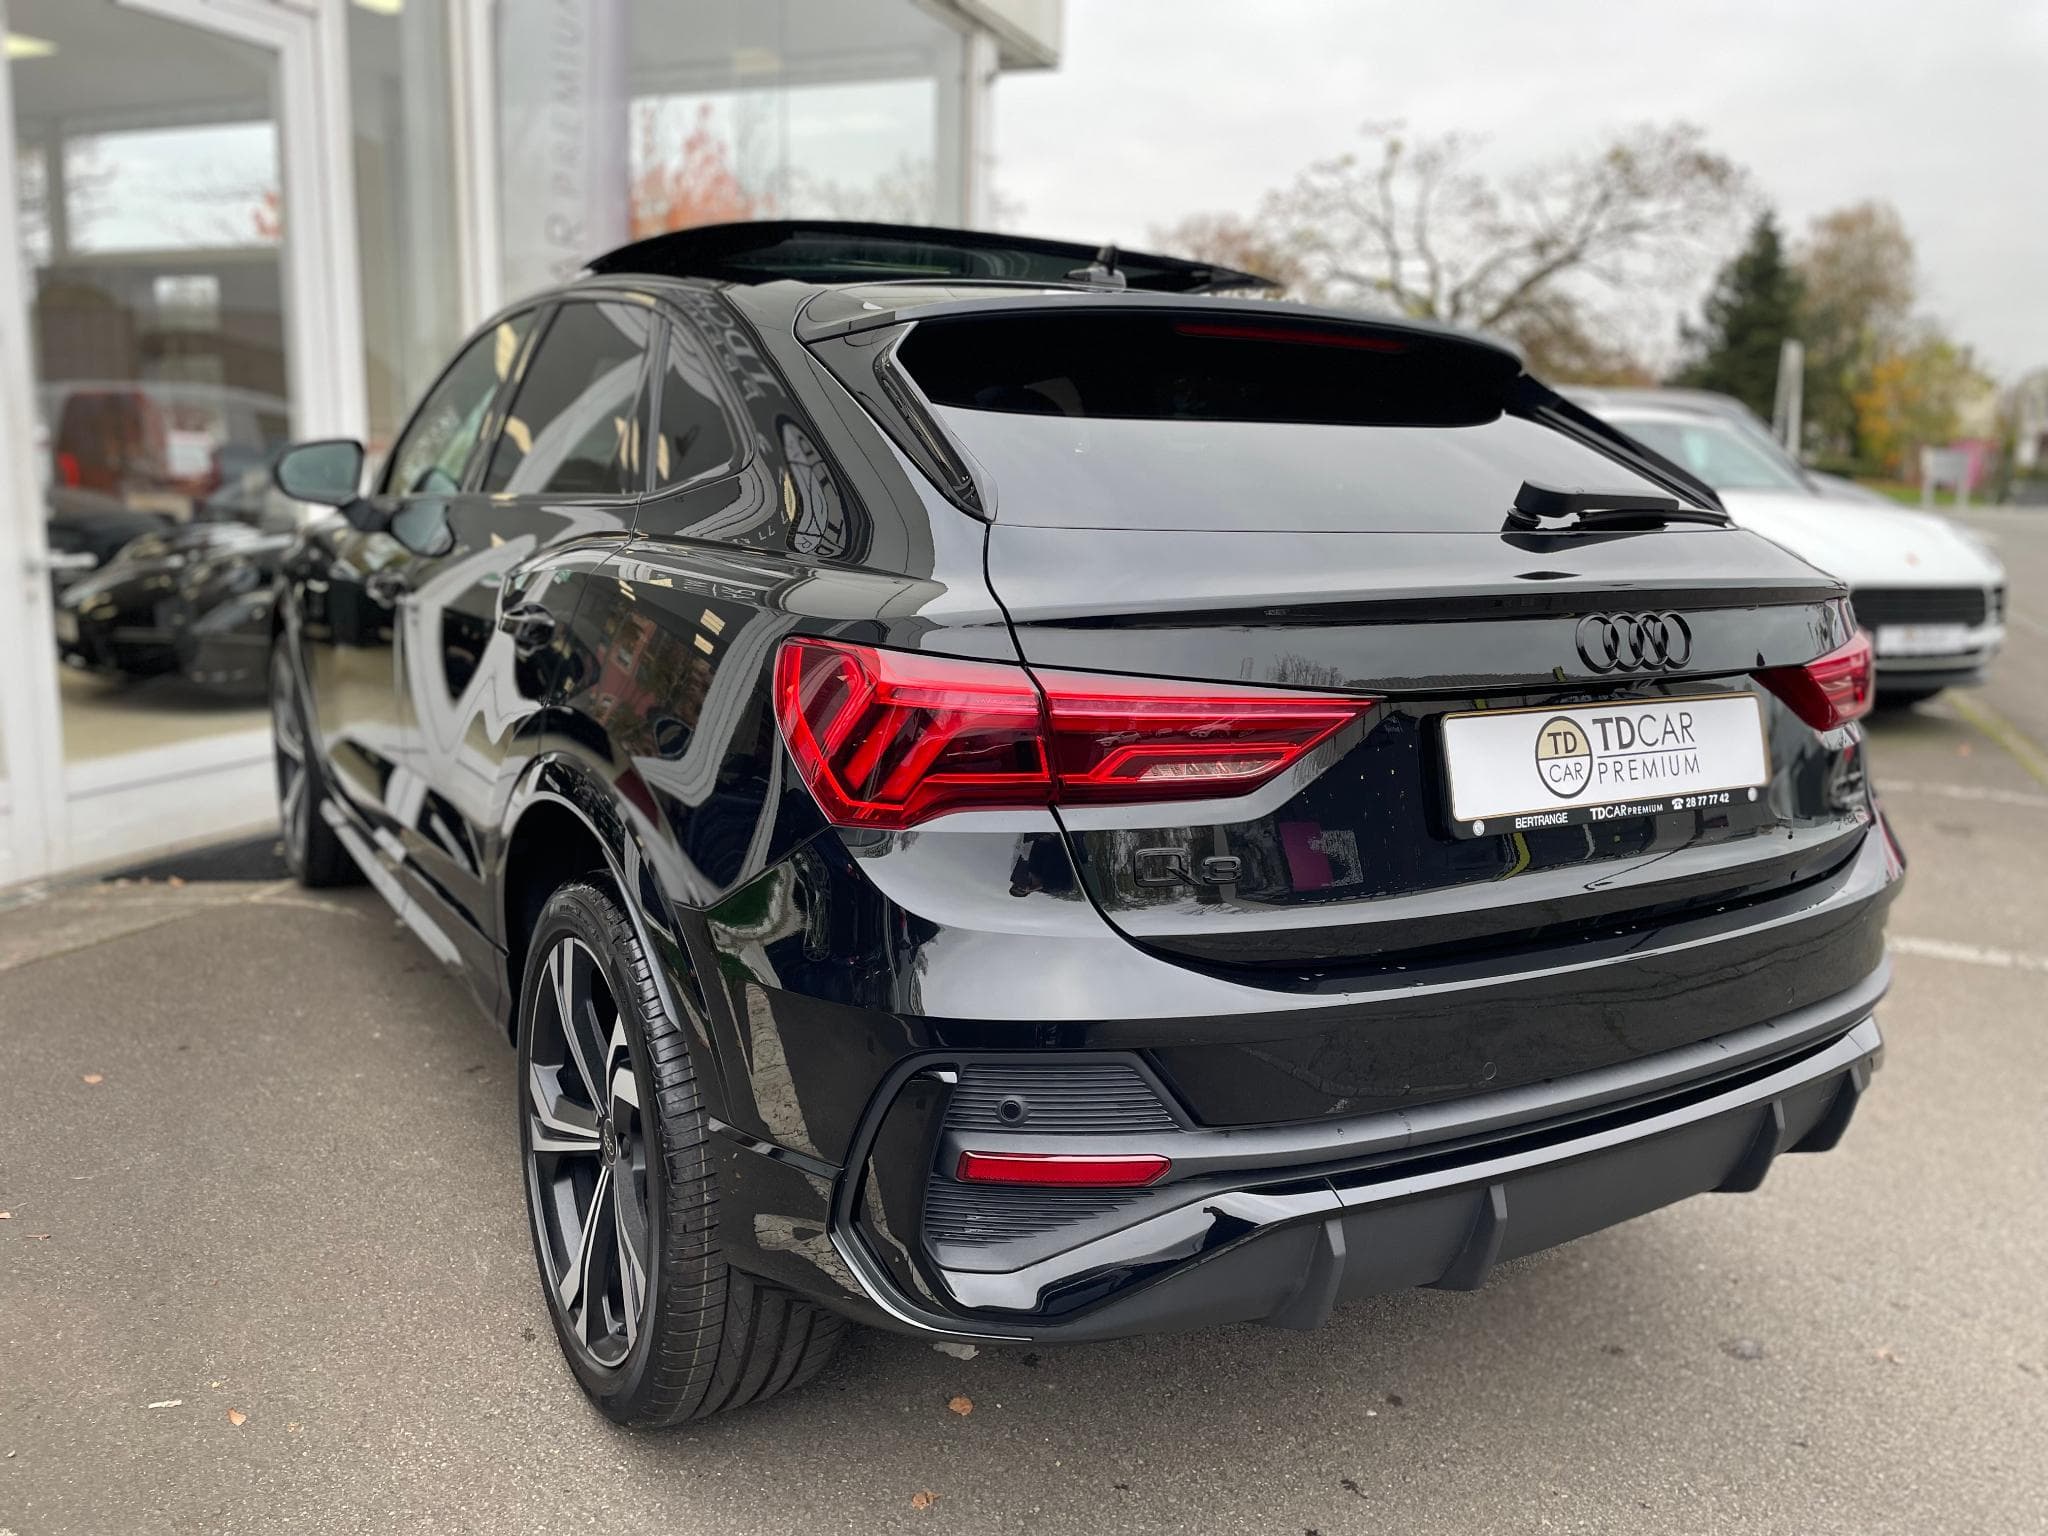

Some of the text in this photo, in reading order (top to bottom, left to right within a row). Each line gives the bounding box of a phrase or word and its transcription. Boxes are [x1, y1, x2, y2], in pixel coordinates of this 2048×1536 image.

[1547, 731, 1577, 755] TD
[1592, 712, 1695, 751] TDCAR
[1549, 762, 1584, 783] CAR
[1597, 753, 1700, 785] PREMIUM
[1515, 812, 1569, 829] BERTRANGE
[1686, 797, 1697, 808] 28
[1697, 796, 1707, 806] 77
[1709, 794, 1718, 805] 77
[1719, 792, 1730, 803] 42
[1134, 847, 1241, 888] Q3
